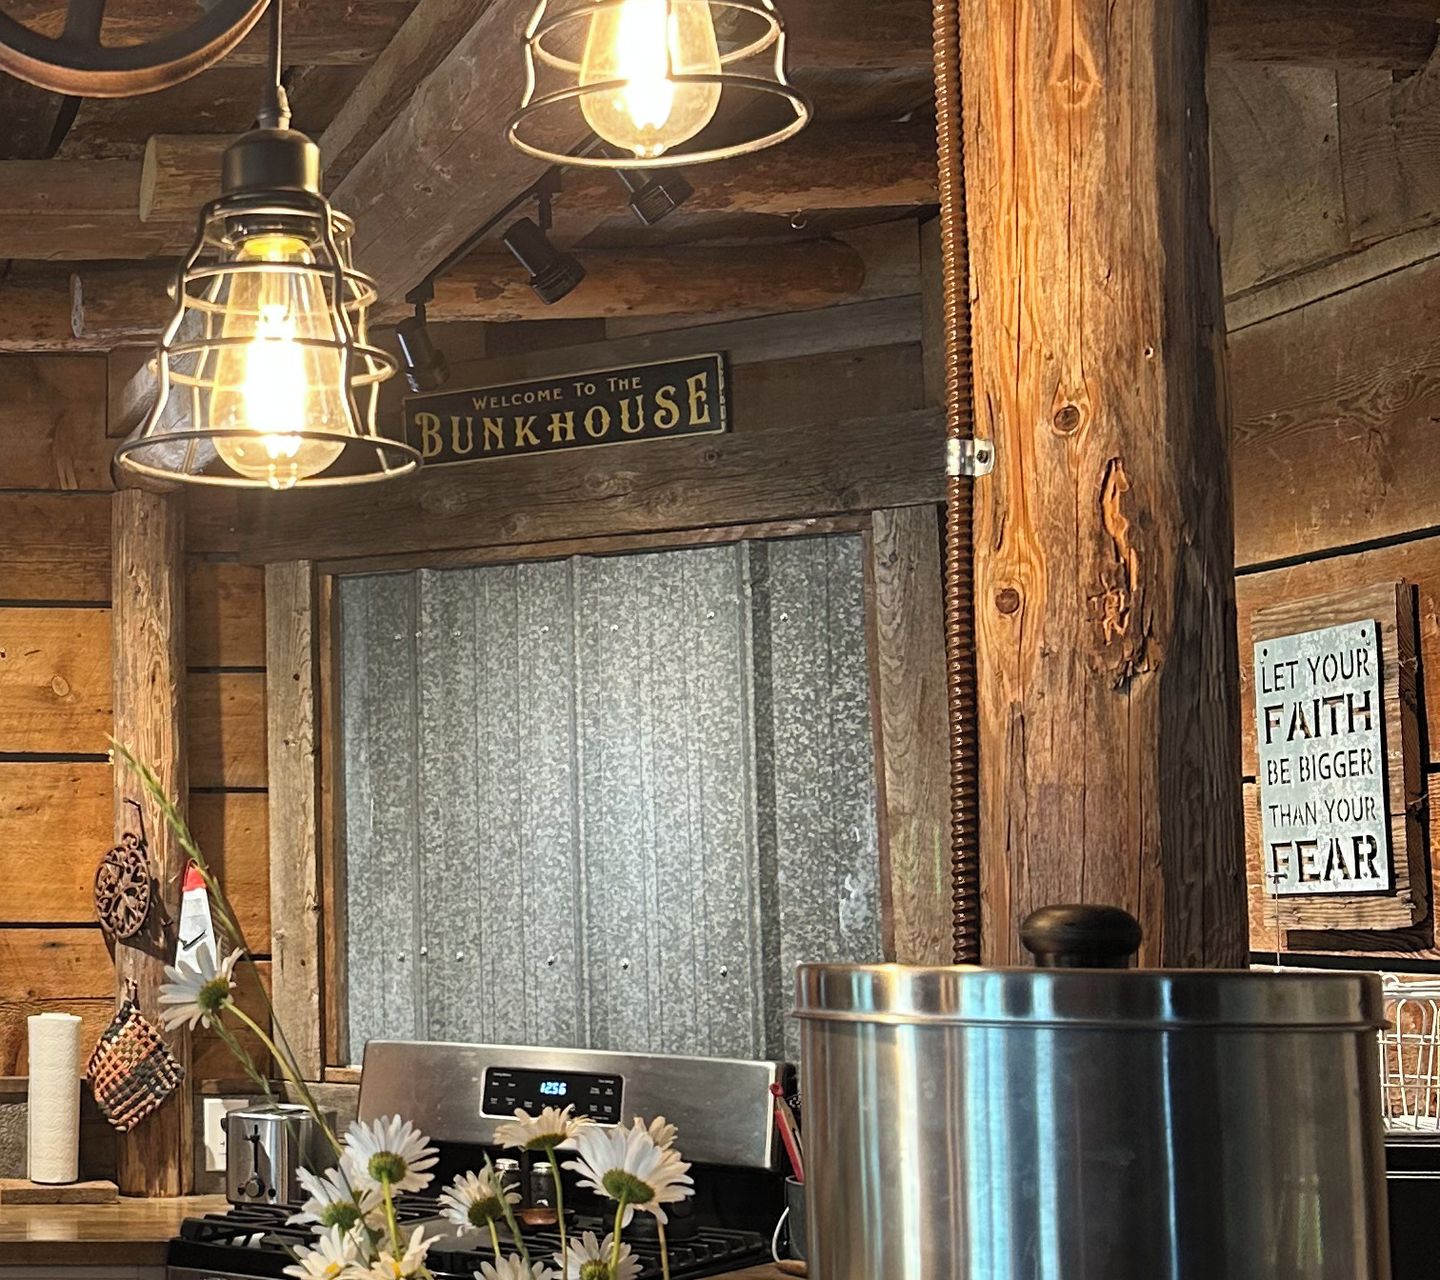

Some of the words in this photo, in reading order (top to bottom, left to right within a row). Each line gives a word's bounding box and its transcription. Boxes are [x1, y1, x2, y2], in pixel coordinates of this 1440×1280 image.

[414, 371, 712, 458] BUNKHOUSE
[472, 387, 563, 412] WELCOME
[573, 381, 596, 398] TO
[607, 376, 642, 393] THE
[1261, 660, 1299, 694] LET
[1307, 647, 1370, 684] YOUR
[1264, 689, 1373, 744] FAITH
[1267, 757, 1290, 786] BE
[1299, 747, 1374, 782] BIGGER
[1268, 803, 1317, 828] THAN
[1324, 796, 1377, 825] YOUR
[1270, 833, 1381, 884] FEAR
